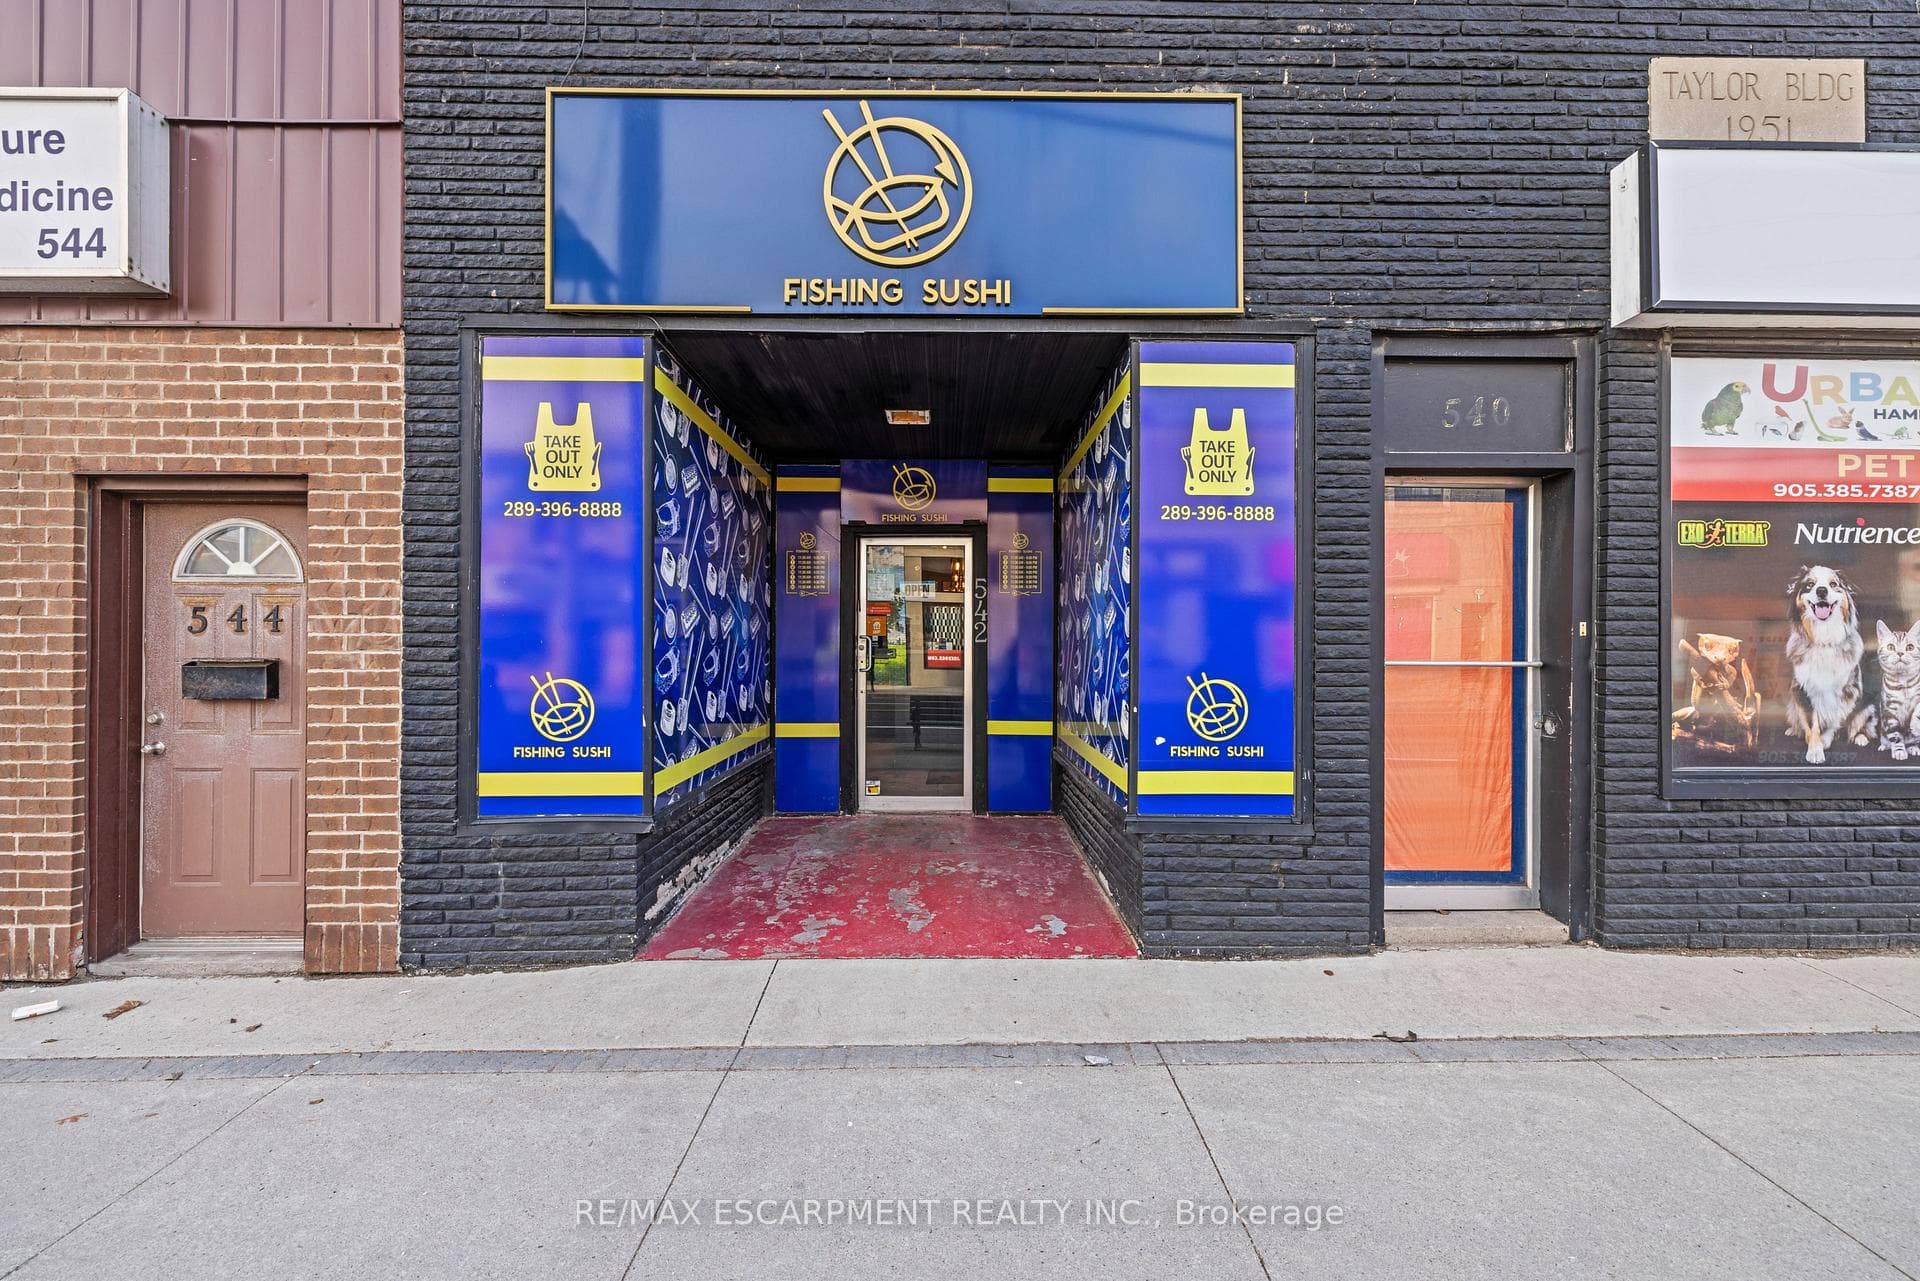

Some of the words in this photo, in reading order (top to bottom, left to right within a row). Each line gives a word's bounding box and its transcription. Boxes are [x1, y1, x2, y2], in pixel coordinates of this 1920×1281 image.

[1661, 71, 1762, 102] TAYLOR
[1785, 72, 1854, 102] BLDG
[1726, 114, 1793, 141] 1951
[1, 129, 66, 155] ure
[0, 179, 114, 212] dicine
[36, 226, 107, 260] 544
[783, 278, 904, 305] FISHING
[922, 278, 1012, 305] SUSHI
[1761, 363, 1920, 407] URBA
[1441, 396, 1511, 429] 540
[1873, 408, 1920, 420] HAM
[543, 435, 582, 449] TAKE
[1199, 440, 1236, 454] TAKE
[545, 449, 581, 464] OUT
[1201, 454, 1235, 469] OUT
[1837, 454, 1916, 478] PET
[543, 465, 583, 480] ONLY
[1198, 470, 1237, 484] ONLY
[1773, 483, 1920, 499] 905.385.7387
[503, 501, 623, 518] 289-396-8888
[881, 513, 917, 522] FISHING
[921, 513, 948, 522] SUSHI
[1160, 504, 1276, 521] 289-396-8888
[1680, 522, 1705, 544] EXO
[1724, 523, 1766, 544] TERRA
[1793, 517, 1920, 545] Nutrience
[187, 603, 284, 635] 544
[974, 577, 988, 643] 542
[513, 746, 566, 759] FISHING
[572, 746, 612, 759] SUSHI
[1170, 745, 1220, 758] FISHING
[1226, 745, 1264, 758] SUSHI
